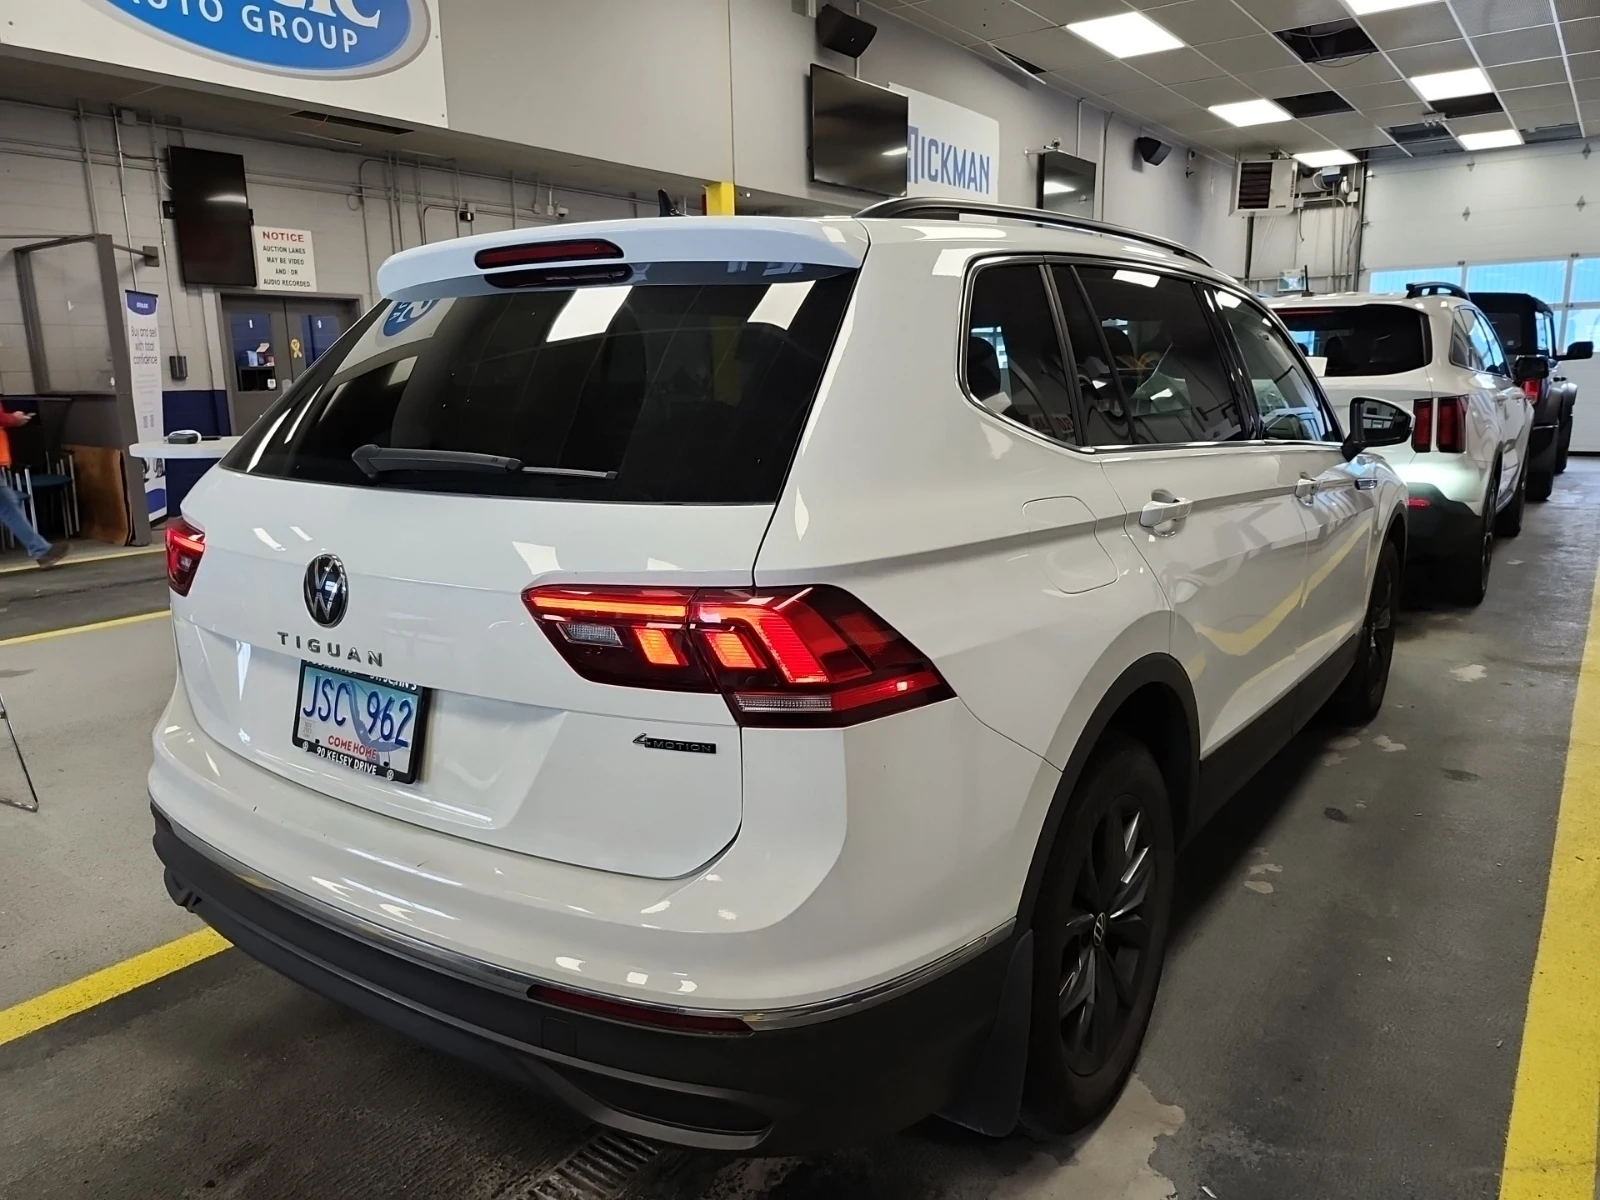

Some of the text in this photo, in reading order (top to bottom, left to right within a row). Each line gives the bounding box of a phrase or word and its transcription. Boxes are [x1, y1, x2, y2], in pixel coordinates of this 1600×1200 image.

[241, 4, 358, 53] GROUP
[262, 231, 304, 242] NOTICE
[277, 631, 384, 667] TIGUAN
[303, 674, 413, 748] JSC 962
[316, 746, 378, 775] 90 KELSEY DRIVE
[328, 735, 377, 760] COME HOME
